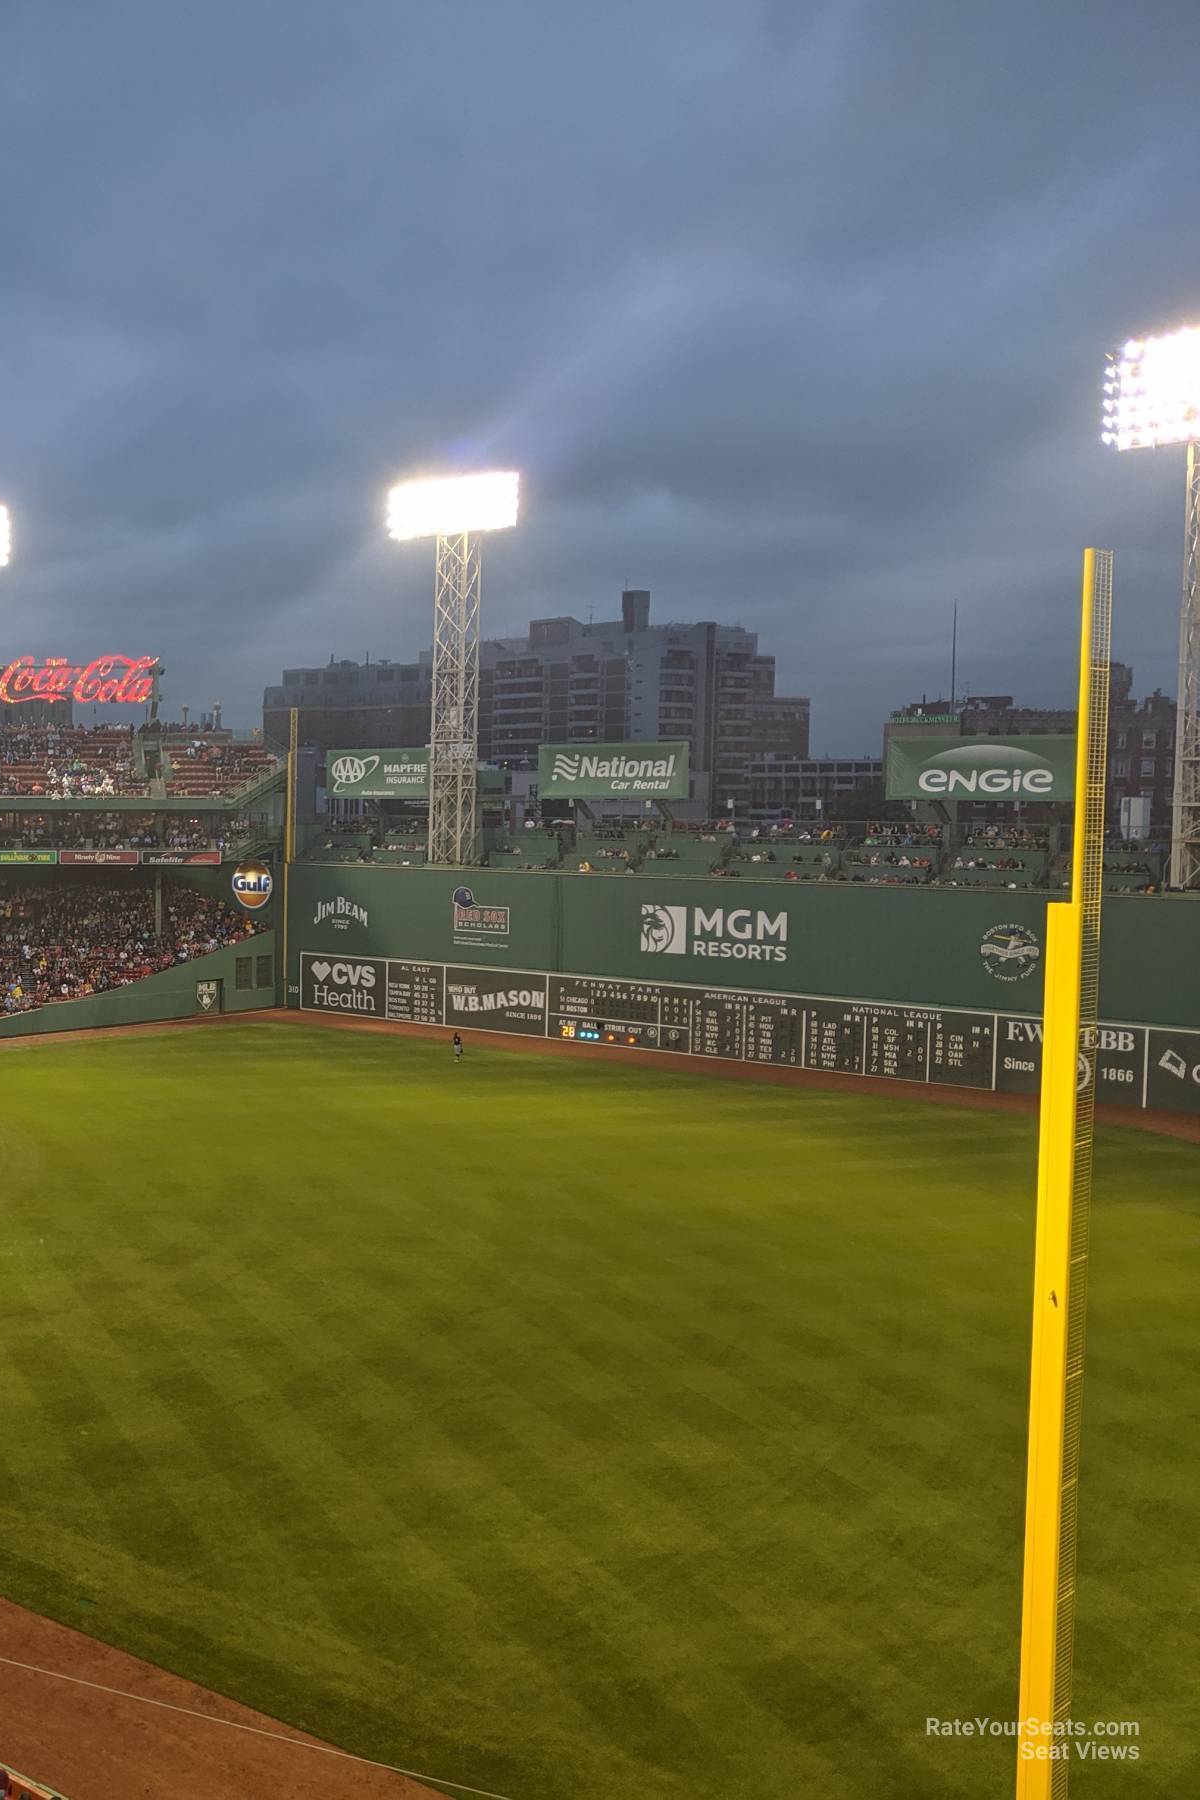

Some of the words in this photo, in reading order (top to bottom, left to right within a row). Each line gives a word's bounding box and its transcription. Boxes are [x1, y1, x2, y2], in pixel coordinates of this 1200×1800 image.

[384, 764, 428, 773] MAPFRE
[580, 755, 675, 778] National
[386, 776, 425, 784] INSURANCE
[611, 780, 630, 790] Car
[633, 780, 670, 790] Rental
[233, 876, 271, 892] Gulf
[314, 900, 335, 924] JIM
[336, 896, 368, 928] BEAM
[457, 908, 480, 922] RED
[483, 910, 506, 924] SOX
[458, 922, 506, 930] SCHOLARS
[694, 906, 788, 942] MGM
[693, 940, 788, 962] RESORTS
[332, 962, 376, 988] CVS
[288, 985, 299, 994] 310
[448, 985, 463, 993] WHO
[464, 986, 477, 994] BUY
[575, 980, 621, 991] FENWAY
[313, 985, 376, 1011] Health
[704, 992, 748, 1002] AMERICAN
[752, 997, 787, 1006] LEAGUE
[852, 1006, 899, 1017] NATIONAL
[903, 1011, 942, 1020] LEAGUE
[562, 1026, 575, 1038] 28
[582, 1021, 597, 1029] BALL
[604, 1024, 625, 1033] STRIKE
[1004, 1057, 1035, 1072] Since
[1101, 1067, 1134, 1082] 1866
